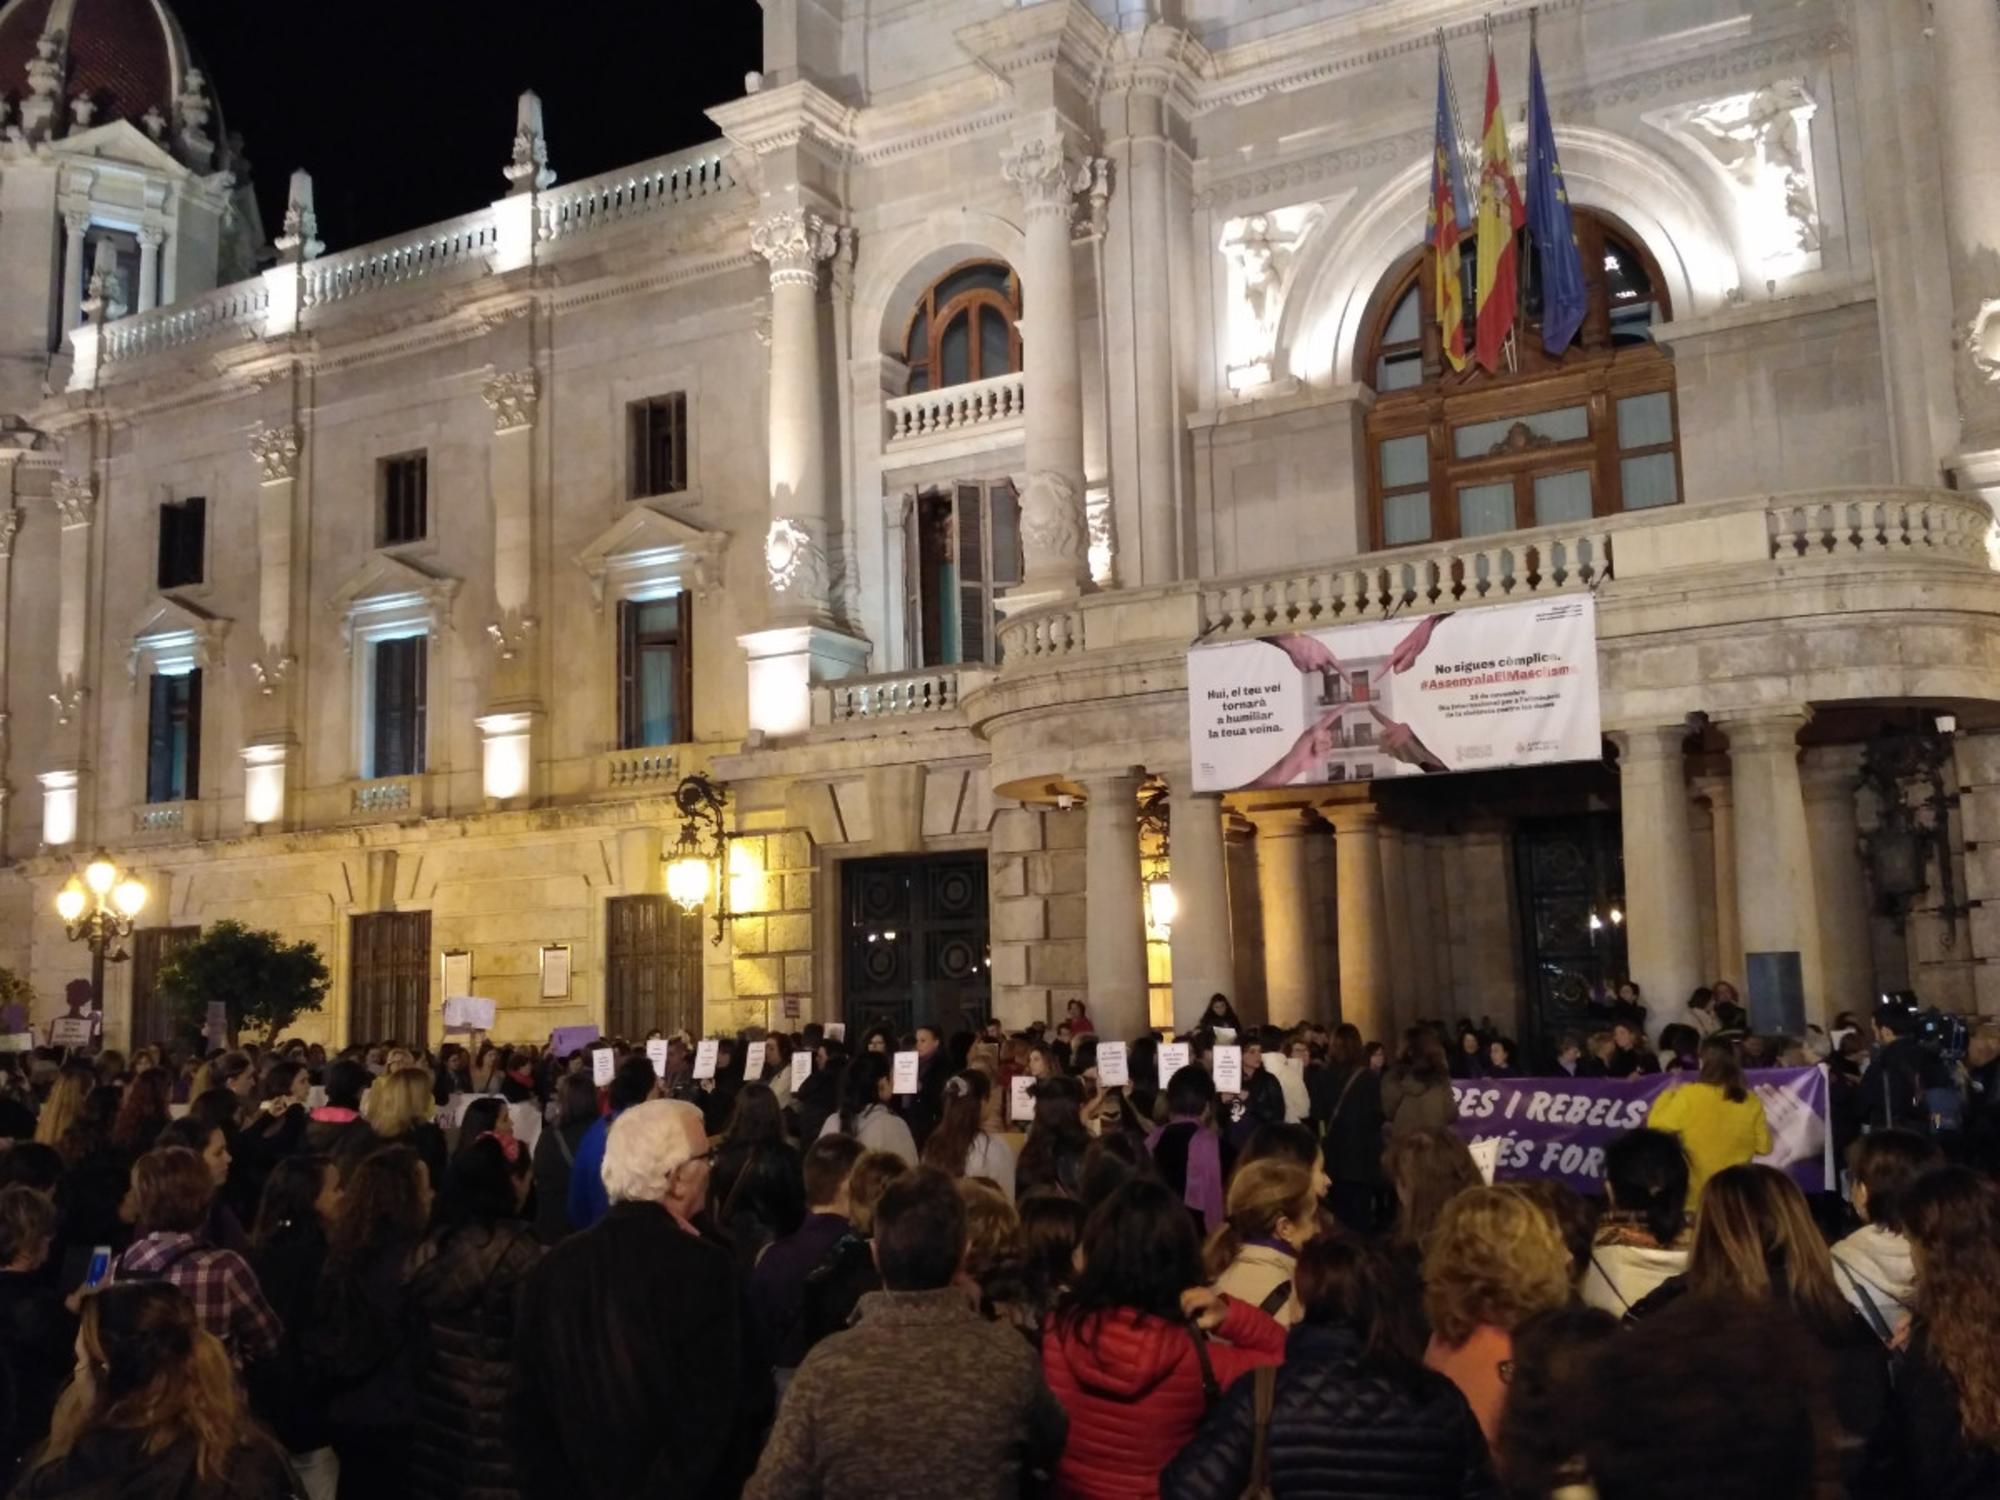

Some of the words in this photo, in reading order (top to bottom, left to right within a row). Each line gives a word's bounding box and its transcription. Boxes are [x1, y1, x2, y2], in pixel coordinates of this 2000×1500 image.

[1435, 664, 1452, 675] No
[1454, 659, 1496, 674] sigues
[1420, 665, 1578, 691] #AssenyalaElMasclism
[1207, 689, 1229, 700] Hui,
[1231, 687, 1241, 698] el
[1243, 686, 1262, 696] teu
[1217, 716, 1224, 725] a
[1226, 711, 1274, 724] humiliar
[1208, 728, 1219, 739] la
[1221, 727, 1247, 737] teua
[1504, 1090, 1523, 1120] I
[1526, 1092, 1648, 1129] REBELS
[1468, 1130, 1535, 1169] ÉS
[1540, 1142, 1607, 1179] FOR
